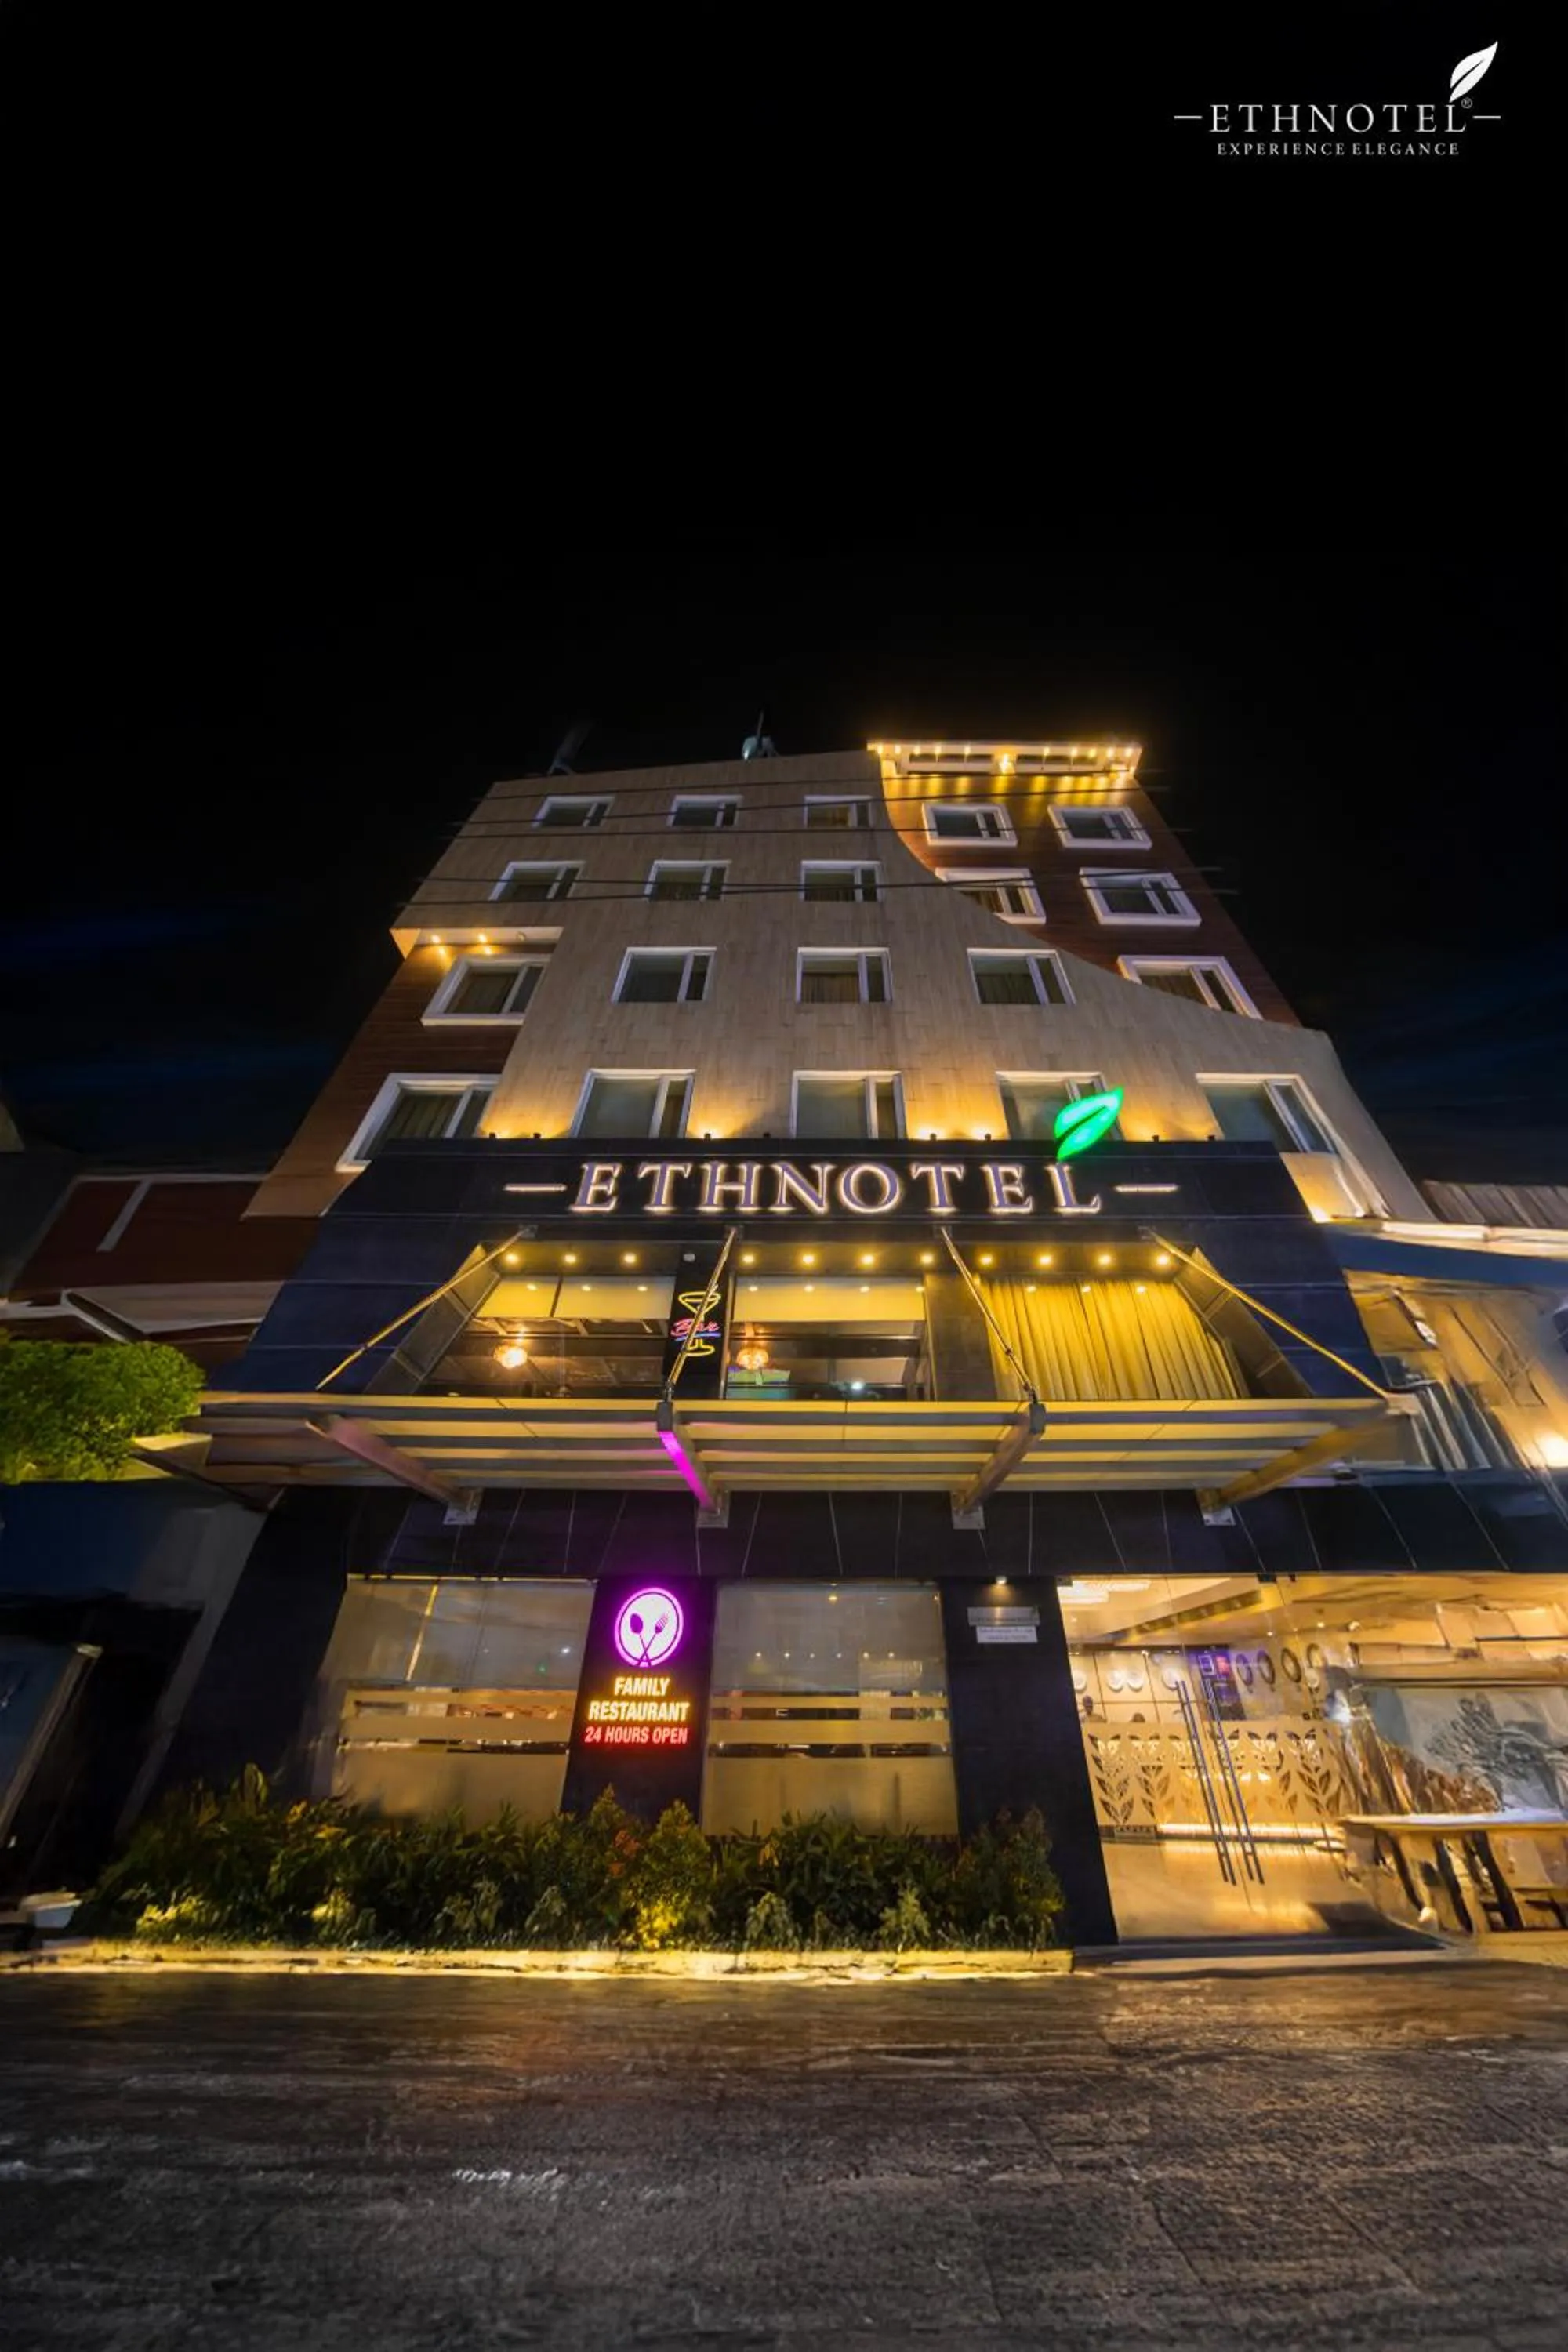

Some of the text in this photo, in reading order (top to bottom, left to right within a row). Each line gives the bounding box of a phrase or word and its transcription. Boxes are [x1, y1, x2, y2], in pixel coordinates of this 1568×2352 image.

[569, 1162, 1101, 1214] ETHNOTEL
[614, 1676, 670, 1696] FAMILY
[588, 1701, 690, 1722] RESTAURANT
[584, 1726, 688, 1744] 24 HOURS OPEN
